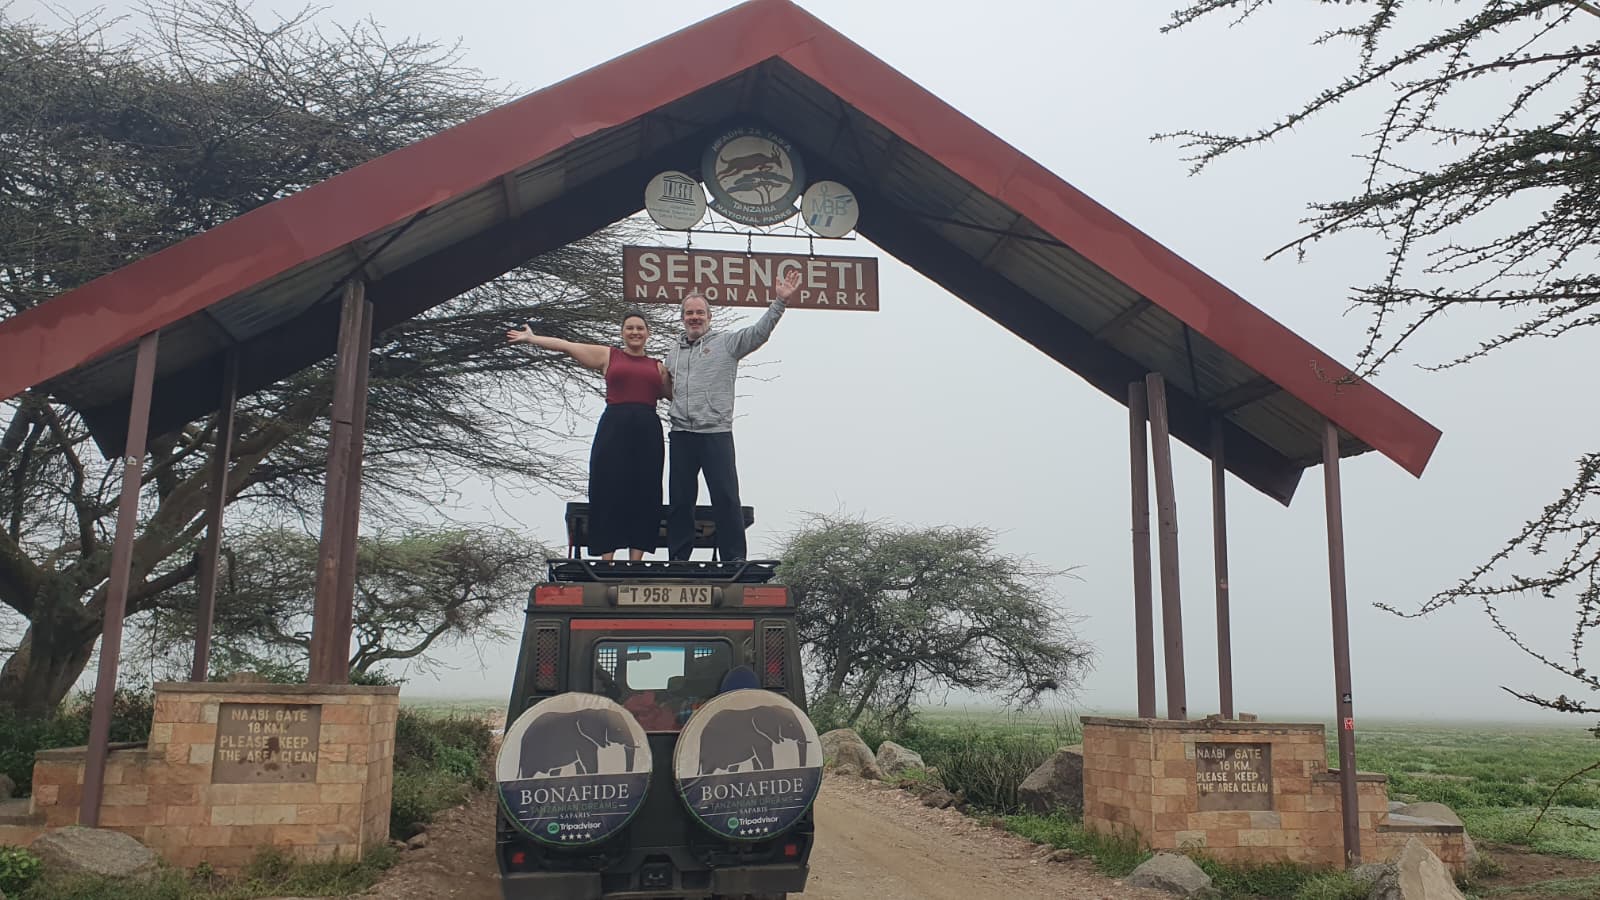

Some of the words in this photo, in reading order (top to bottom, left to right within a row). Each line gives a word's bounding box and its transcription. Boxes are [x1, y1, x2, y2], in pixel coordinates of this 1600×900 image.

[733, 201, 776, 213] TANZANIA
[715, 204, 759, 223] NATIONAL
[763, 208, 792, 223] PARKS
[638, 252, 863, 290] SERENGETI
[800, 290, 867, 306] PARK
[630, 588, 639, 603] T
[643, 587, 670, 603] 958
[680, 587, 708, 603] AYS
[231, 708, 270, 721] NAABI
[275, 709, 308, 722] GATE
[247, 722, 261, 734] 18
[220, 735, 269, 749] PLEASE
[278, 736, 309, 749] KEEP
[219, 750, 240, 761] THE
[247, 750, 278, 762] AREA
[281, 751, 317, 763] CLEAN
[1196, 748, 1226, 760] NAABI
[1234, 748, 1262, 760] GATE
[1196, 771, 1228, 782] PLEASE
[1234, 771, 1259, 782] KEEP
[702, 778, 804, 801] BONAFIDE
[1196, 783, 1214, 793] THE
[1218, 782, 1239, 793] AREA
[1241, 782, 1269, 793] CLEAN
[520, 783, 630, 806] BONAFIDE
[560, 812, 591, 820] SAFARIS
[739, 806, 768, 815] SAFARIS
[560, 821, 601, 831] Tripadvisor
[739, 816, 778, 826] Tripadvisor
